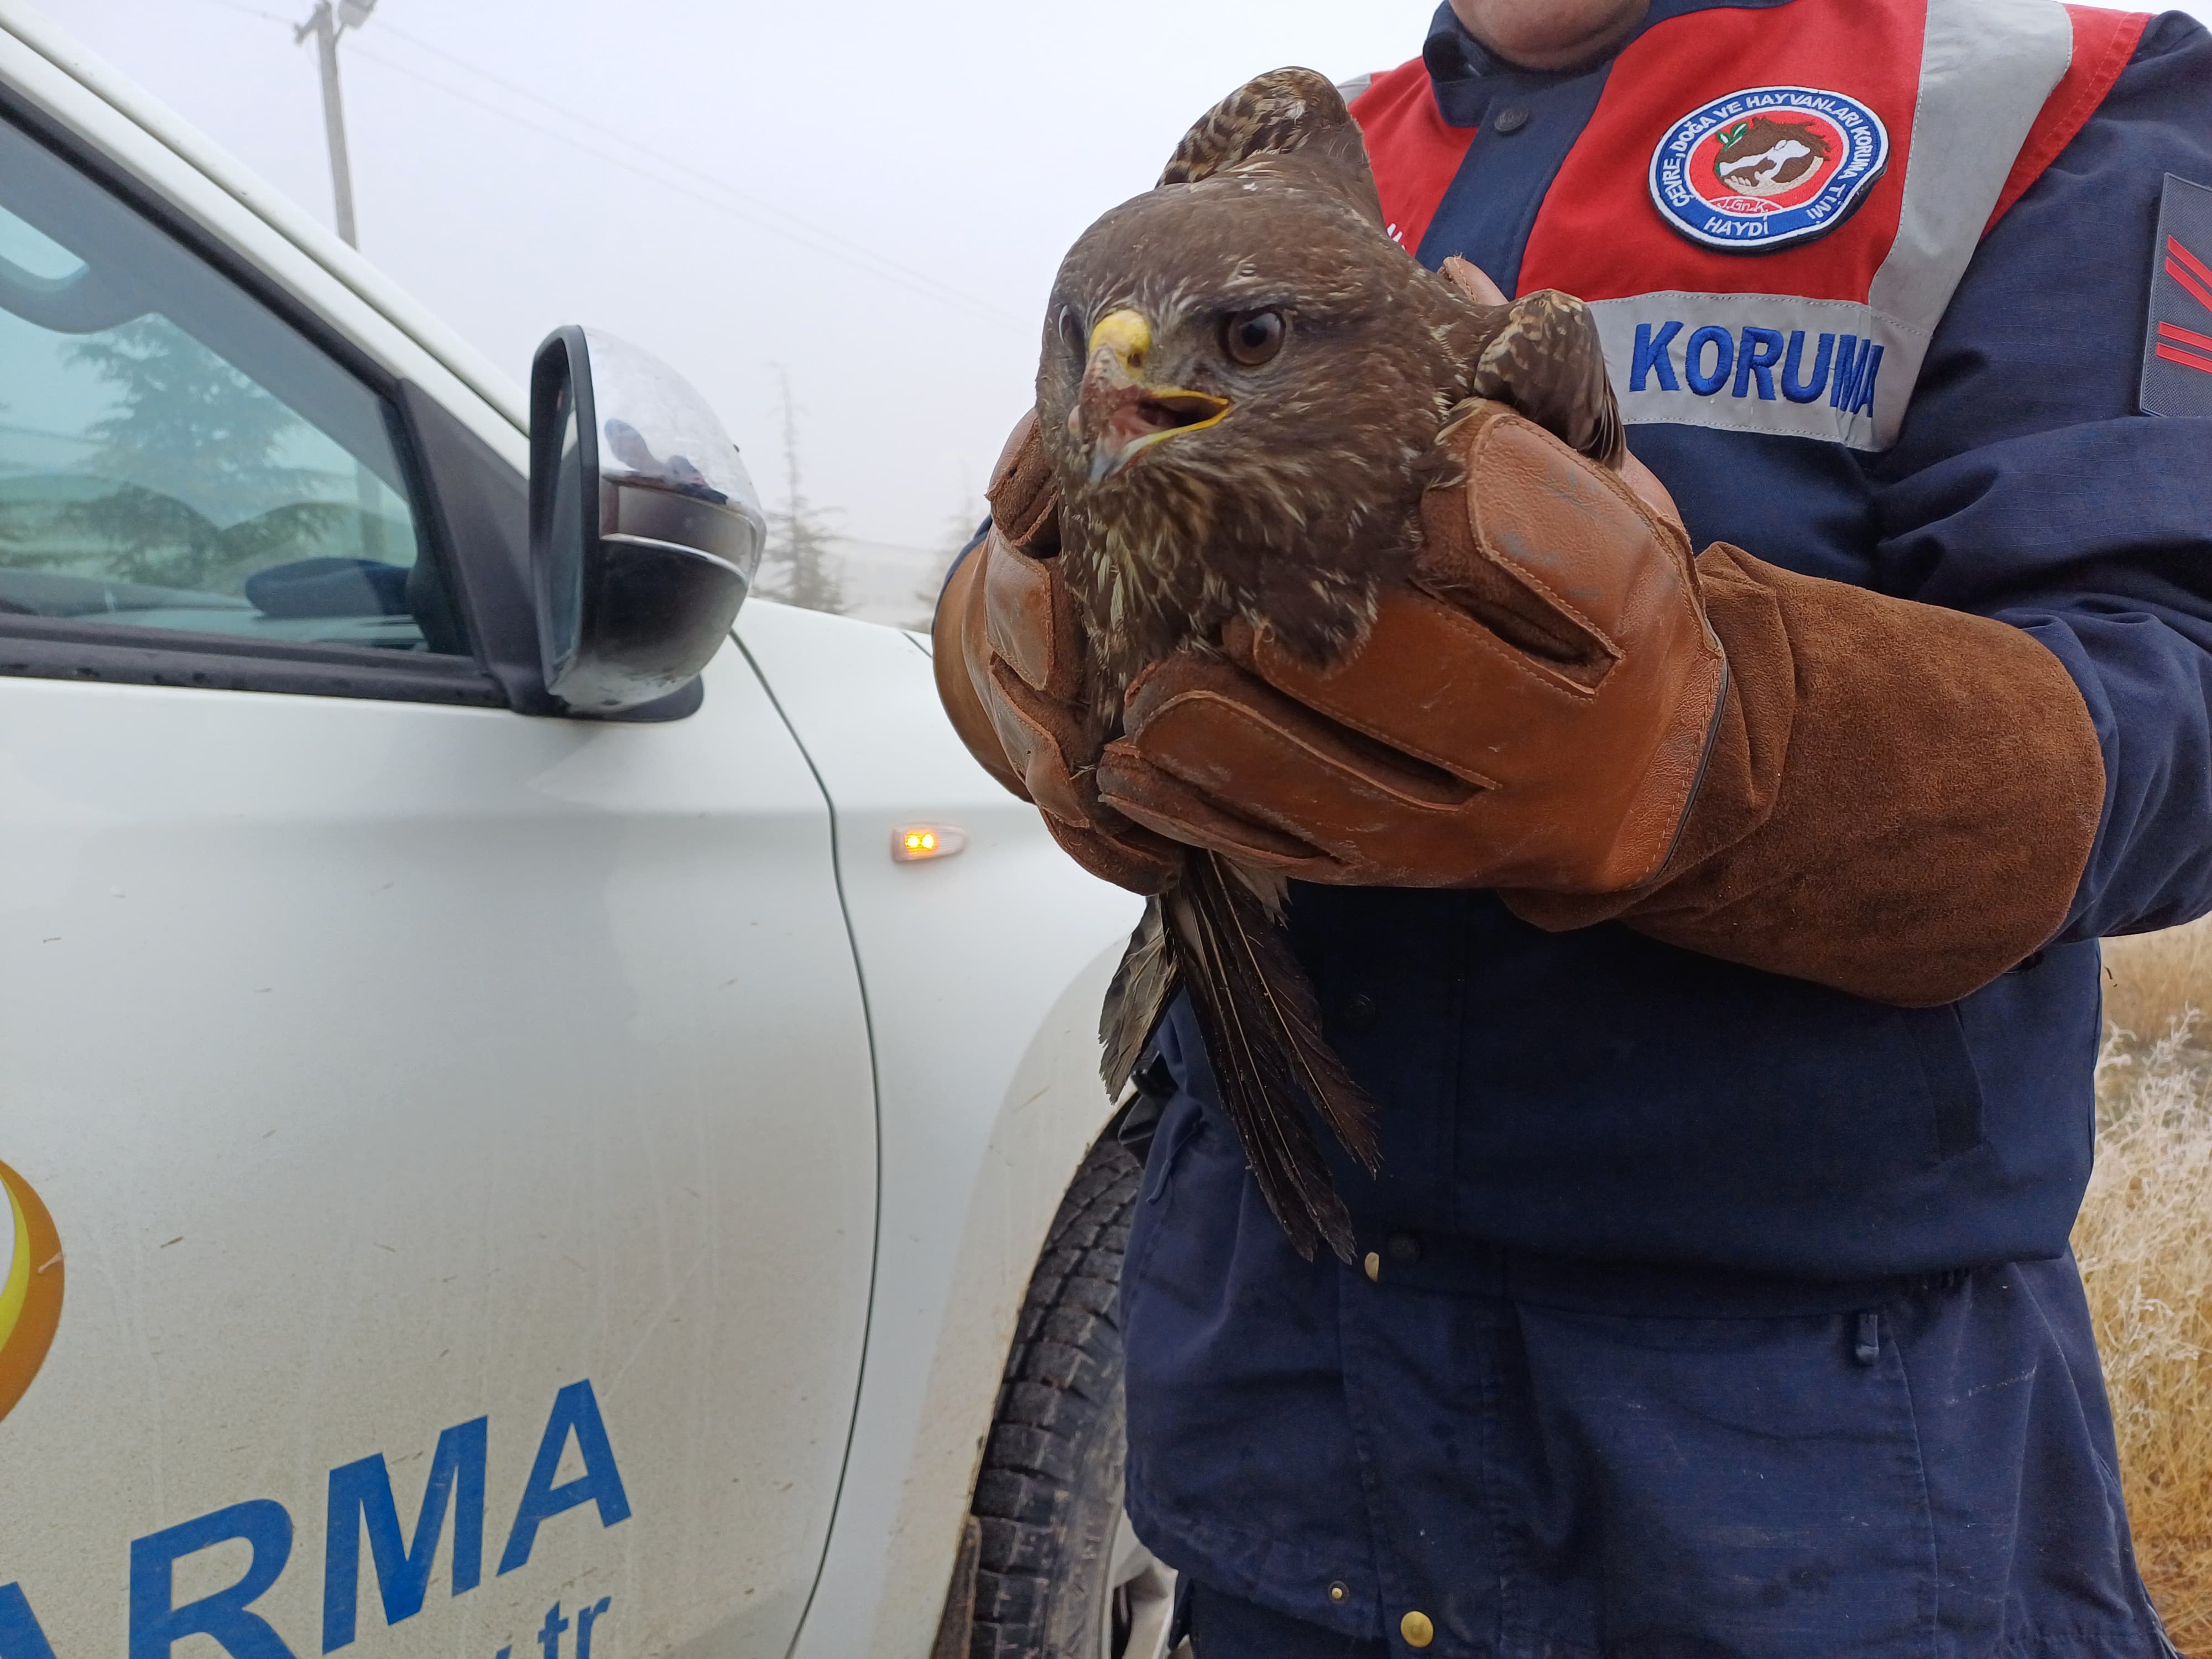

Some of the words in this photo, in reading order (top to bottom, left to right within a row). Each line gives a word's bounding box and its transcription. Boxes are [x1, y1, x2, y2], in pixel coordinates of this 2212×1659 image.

[1719, 101, 1743, 119] VE
[1746, 93, 1860, 128] HAYVANLARI
[1669, 116, 1717, 152] DOĞA
[1843, 126, 1873, 179] KORUMA
[1807, 183, 1848, 225] TİMİ
[1703, 215, 1769, 237] HAYDİ
[1629, 320, 1885, 418] KORUMA
[0, 1378, 632, 1659] RMA
